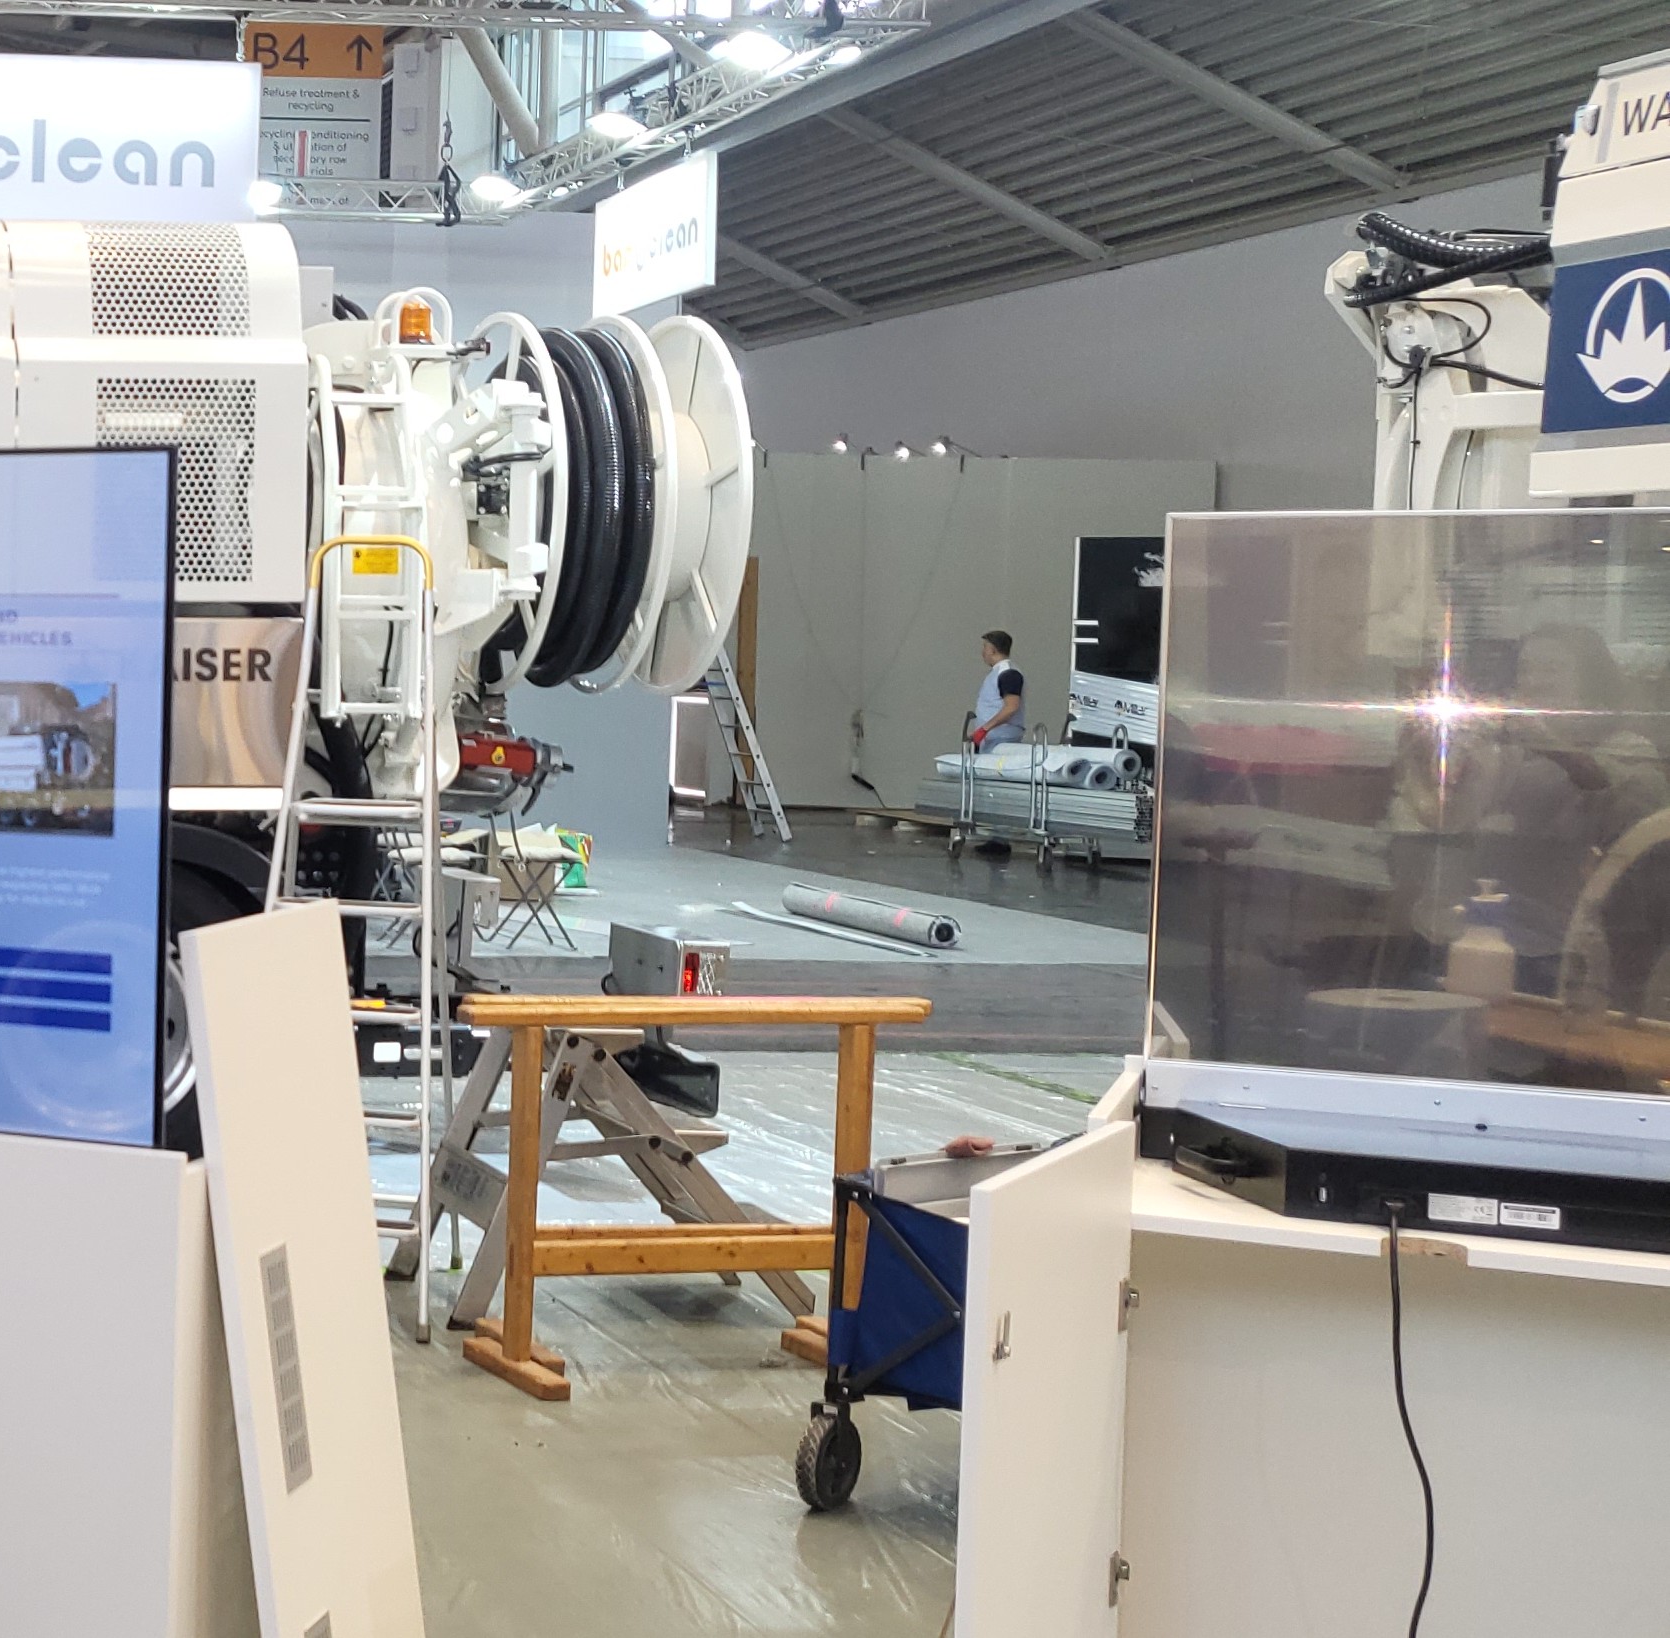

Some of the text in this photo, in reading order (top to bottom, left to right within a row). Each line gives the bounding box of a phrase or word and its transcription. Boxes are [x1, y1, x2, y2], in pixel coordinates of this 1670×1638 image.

[253, 33, 309, 70] B4
[262, 87, 360, 99] Refuse treatment &
[287, 101, 334, 112] recycling
[312, 131, 369, 142] onditioning
[336, 143, 347, 152] of
[328, 156, 347, 164] raw
[171, 648, 272, 682] ISER
